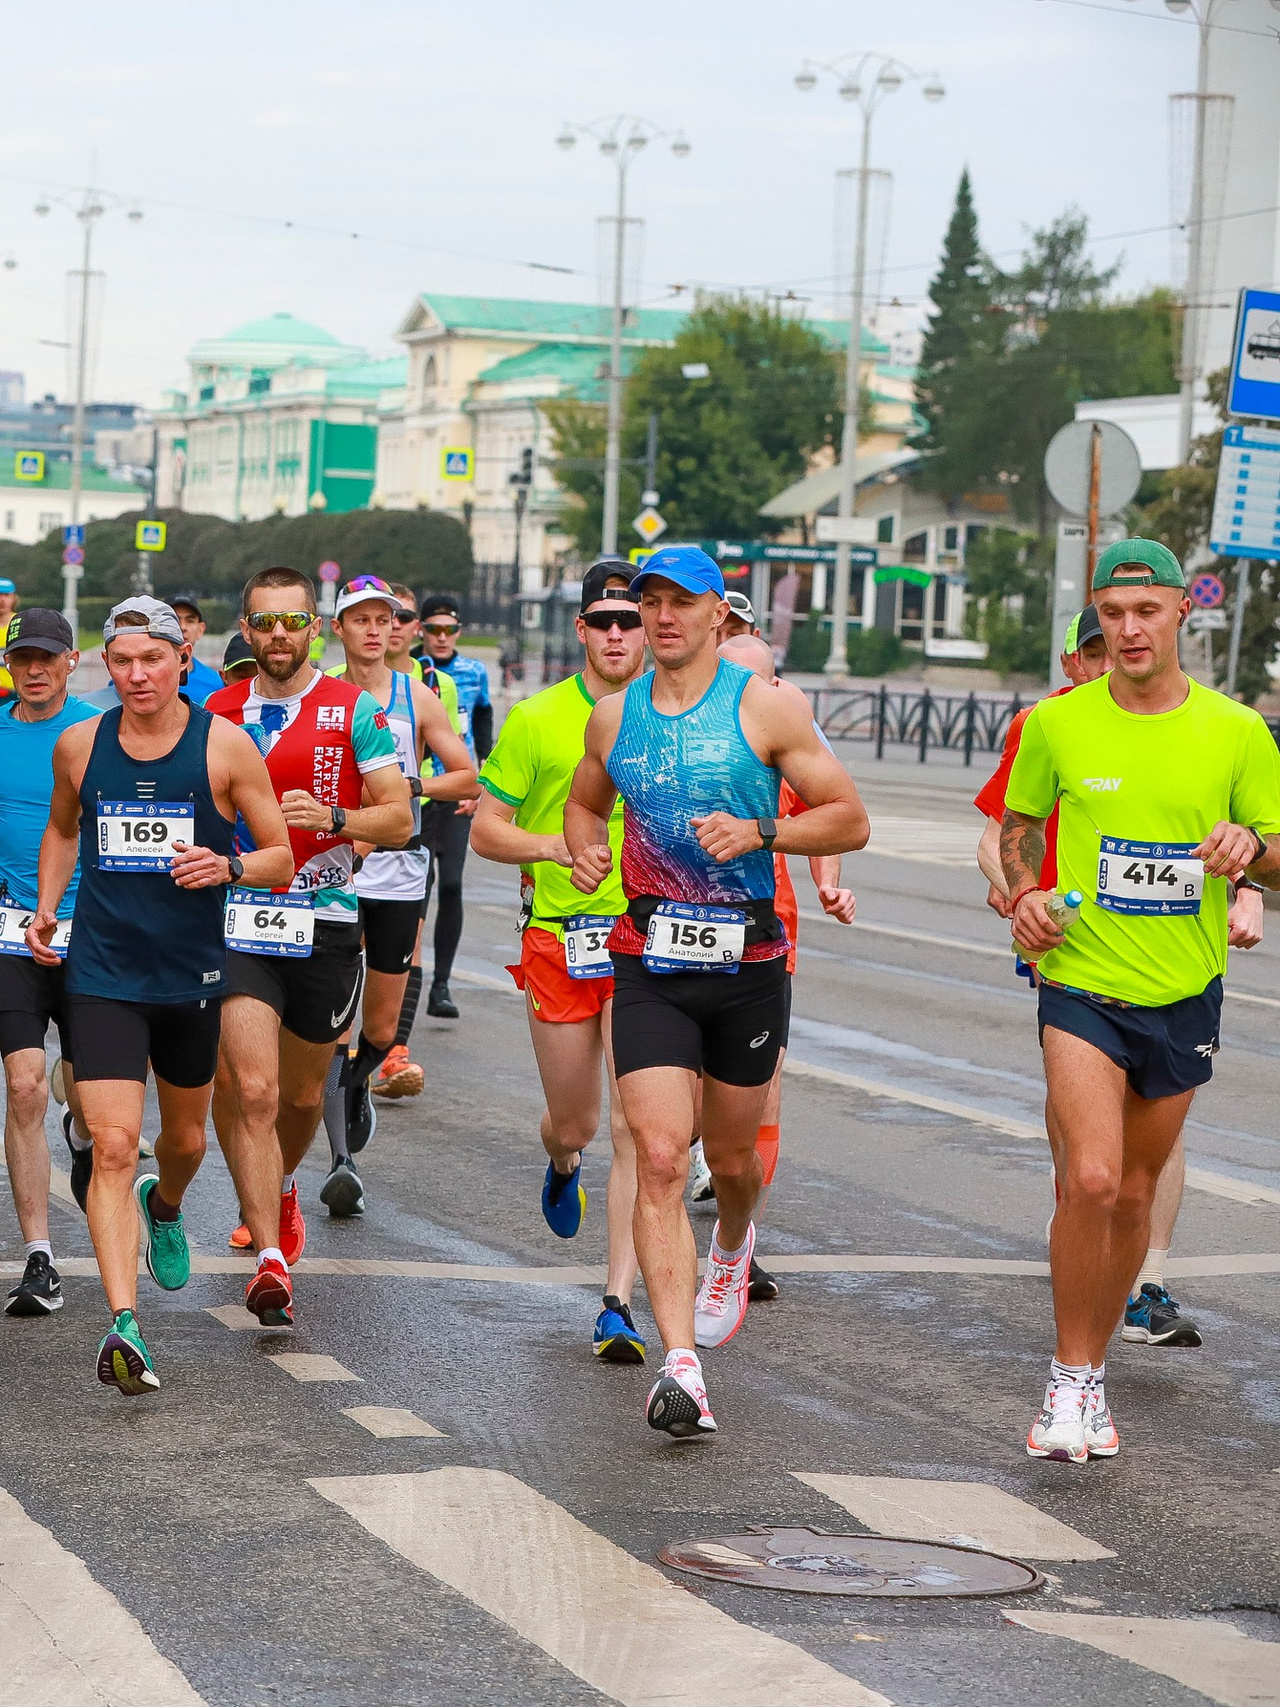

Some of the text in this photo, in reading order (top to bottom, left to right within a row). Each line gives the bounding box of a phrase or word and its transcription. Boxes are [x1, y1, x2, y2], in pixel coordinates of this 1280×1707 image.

[121, 822, 168, 843] 169
[1123, 863, 1178, 886] 414
[254, 910, 287, 930] 64
[254, 931, 284, 940] Сергей
[670, 923, 717, 948] 156
[668, 947, 714, 959] Анатолий
